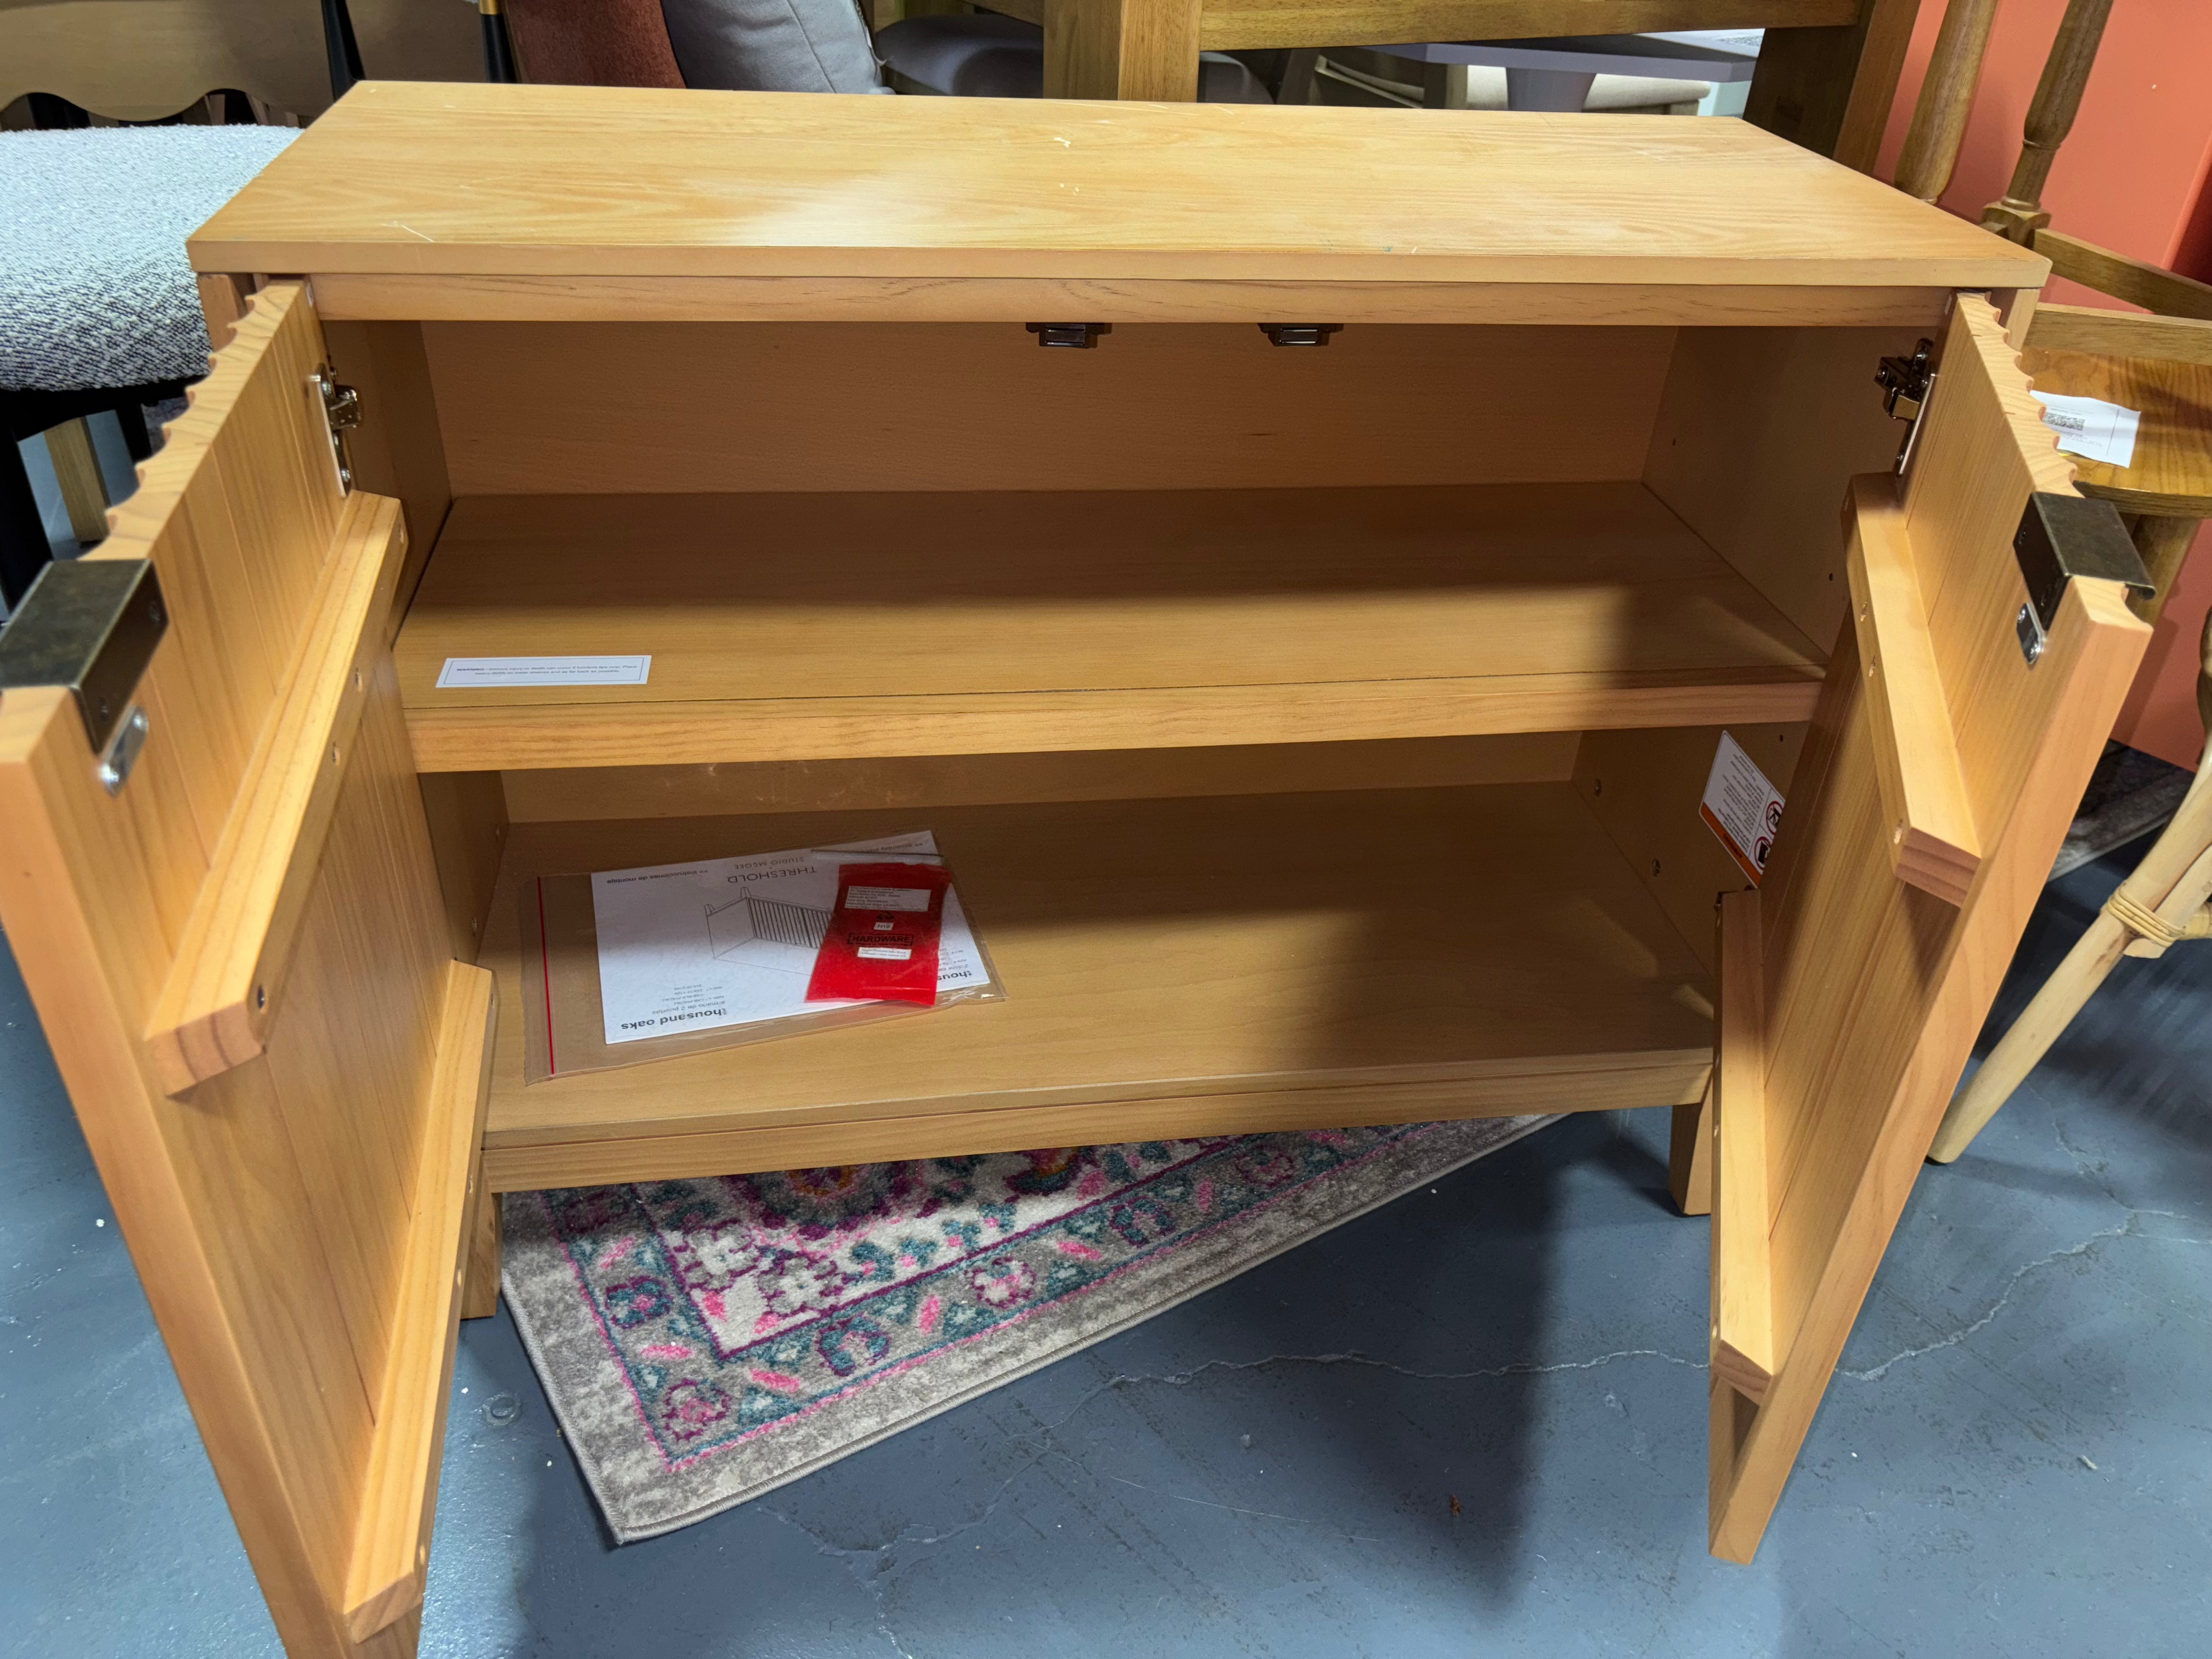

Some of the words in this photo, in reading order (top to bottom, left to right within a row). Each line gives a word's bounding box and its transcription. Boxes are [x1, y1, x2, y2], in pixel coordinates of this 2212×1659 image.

[771, 856, 804, 865] STUDIO
[650, 871, 697, 879] instrucciones
[727, 866, 817, 883] THRESHOLD
[853, 935, 911, 943] HARDWARE
[660, 1008, 727, 1025] thousand
[621, 1019, 654, 1030] oaks
